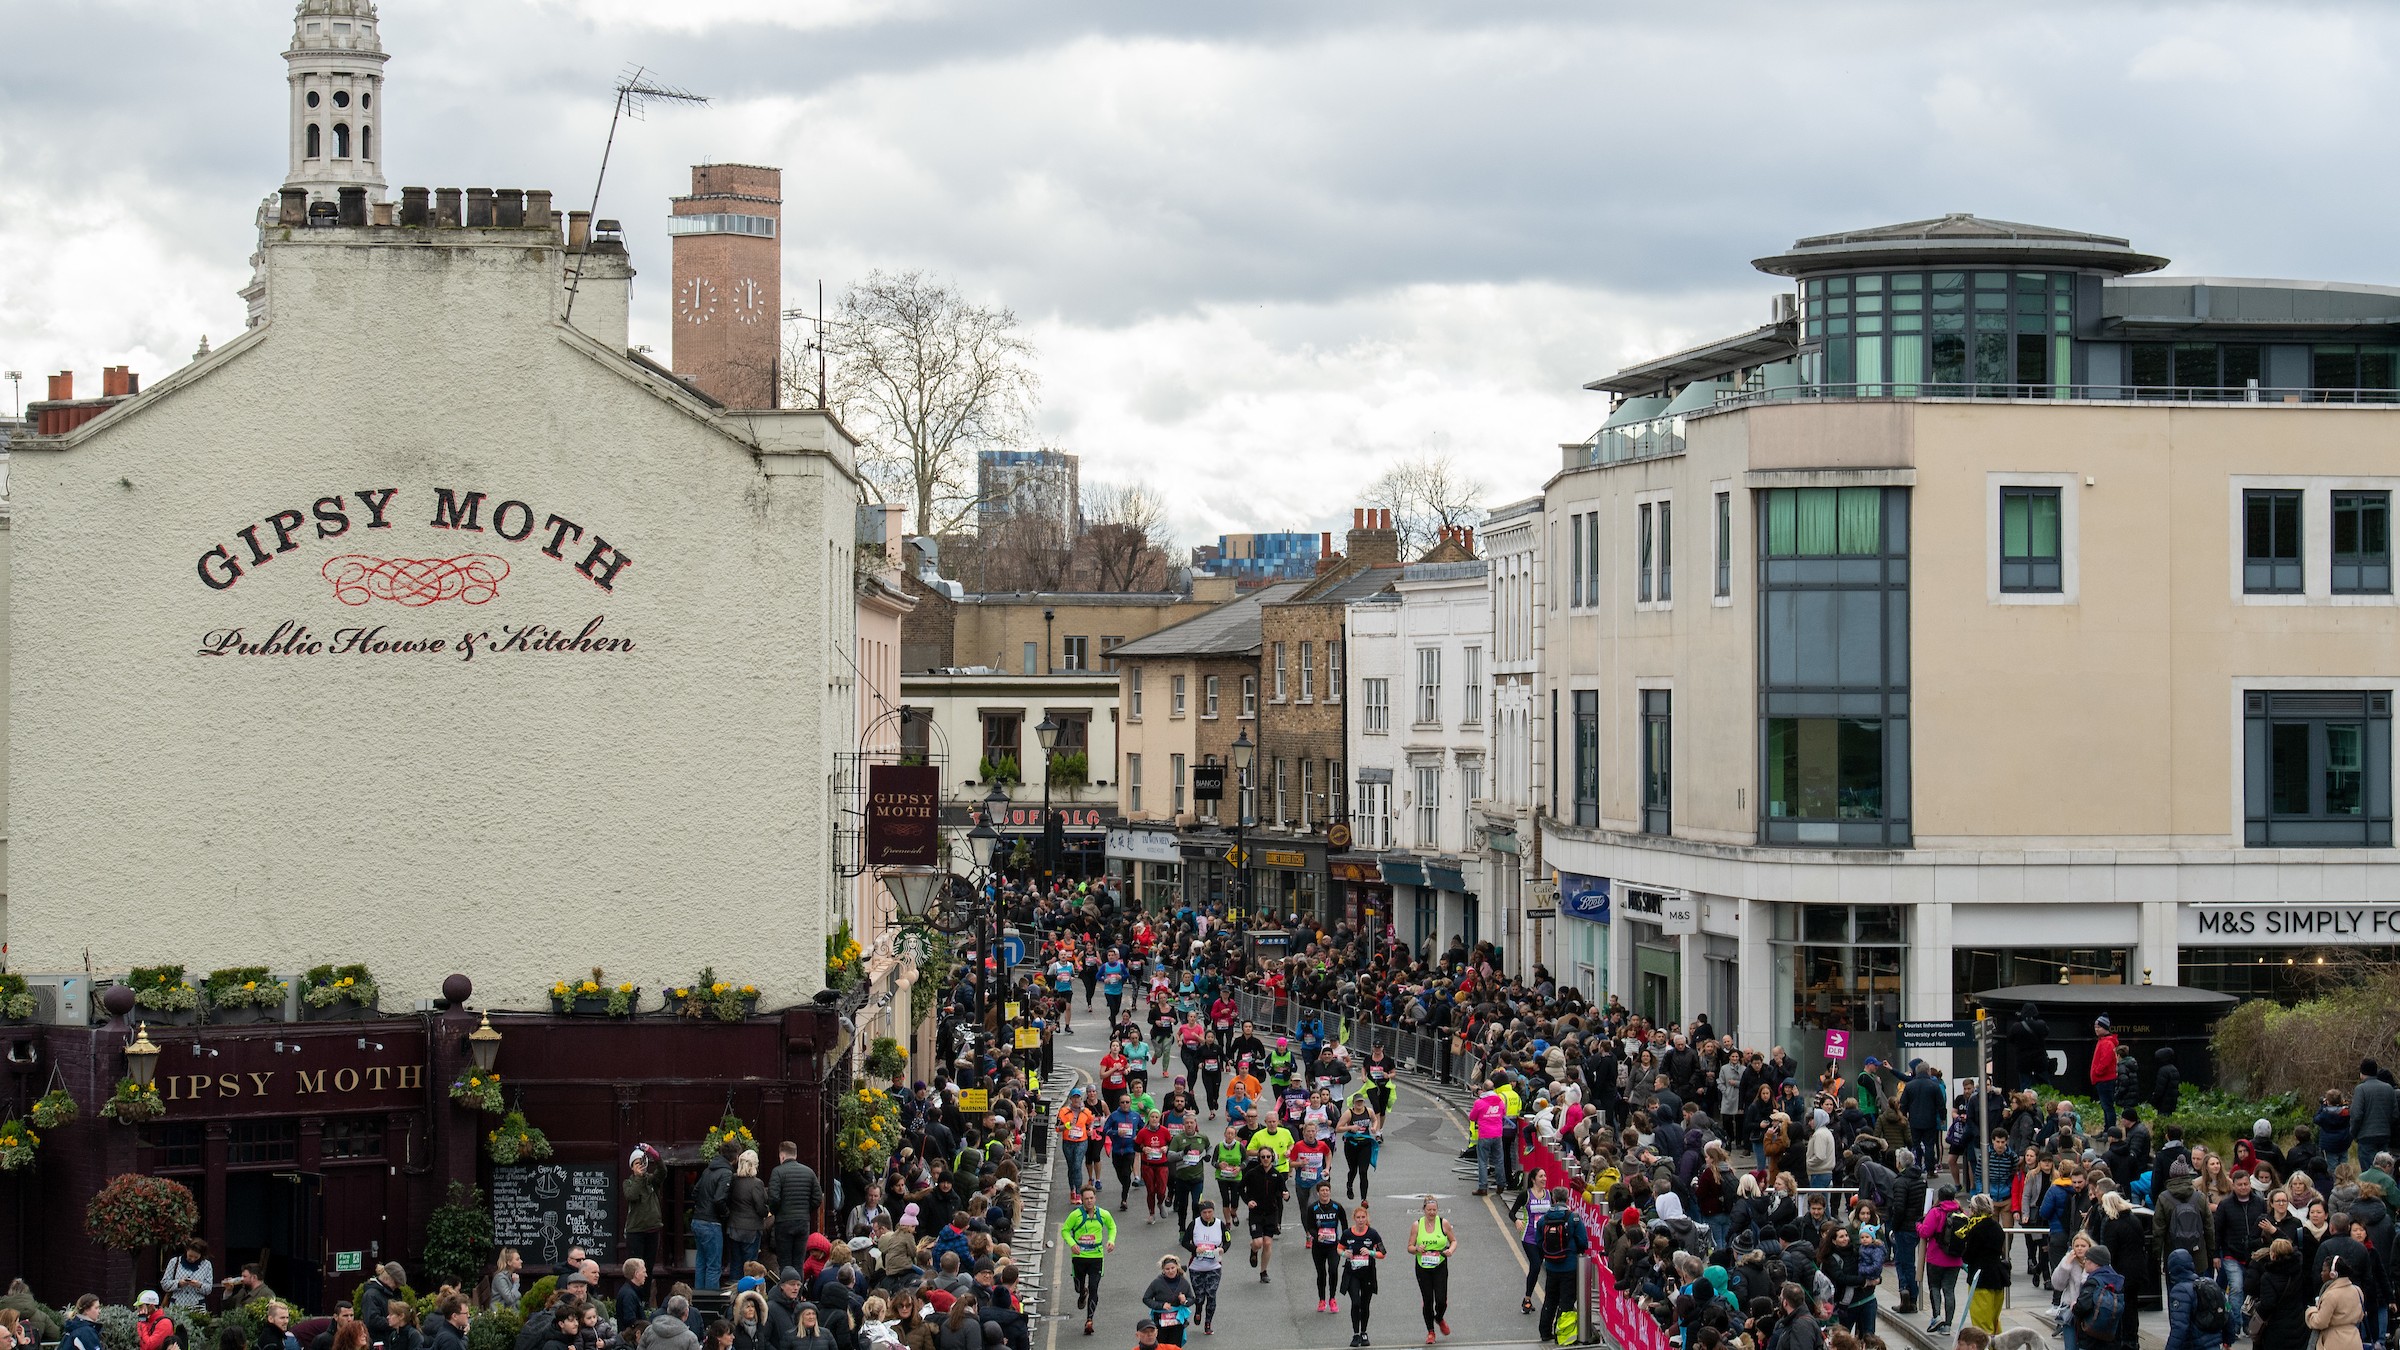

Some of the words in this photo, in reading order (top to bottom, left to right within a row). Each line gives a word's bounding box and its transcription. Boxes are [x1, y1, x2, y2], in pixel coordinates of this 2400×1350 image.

[197, 487, 398, 591] GIPSY
[429, 487, 633, 594] MOTH
[197, 619, 322, 656] Public
[329, 625, 445, 655] House
[456, 632, 487, 661] &
[490, 615, 637, 653] Kitchen
[874, 793, 934, 804] GIPSY
[876, 806, 931, 817] MOTH
[881, 845, 925, 857] Greenwich
[1535, 894, 1552, 908] W
[1577, 896, 1605, 910] Boots
[1670, 911, 1690, 920] M&S
[2200, 911, 2255, 933] M&S
[2266, 911, 2363, 933] SIMPLY
[149, 1072, 274, 1100] IPSY
[296, 1065, 424, 1094] MOTH
[566, 1214, 586, 1225] Craft
[572, 1224, 591, 1234] BEERS
